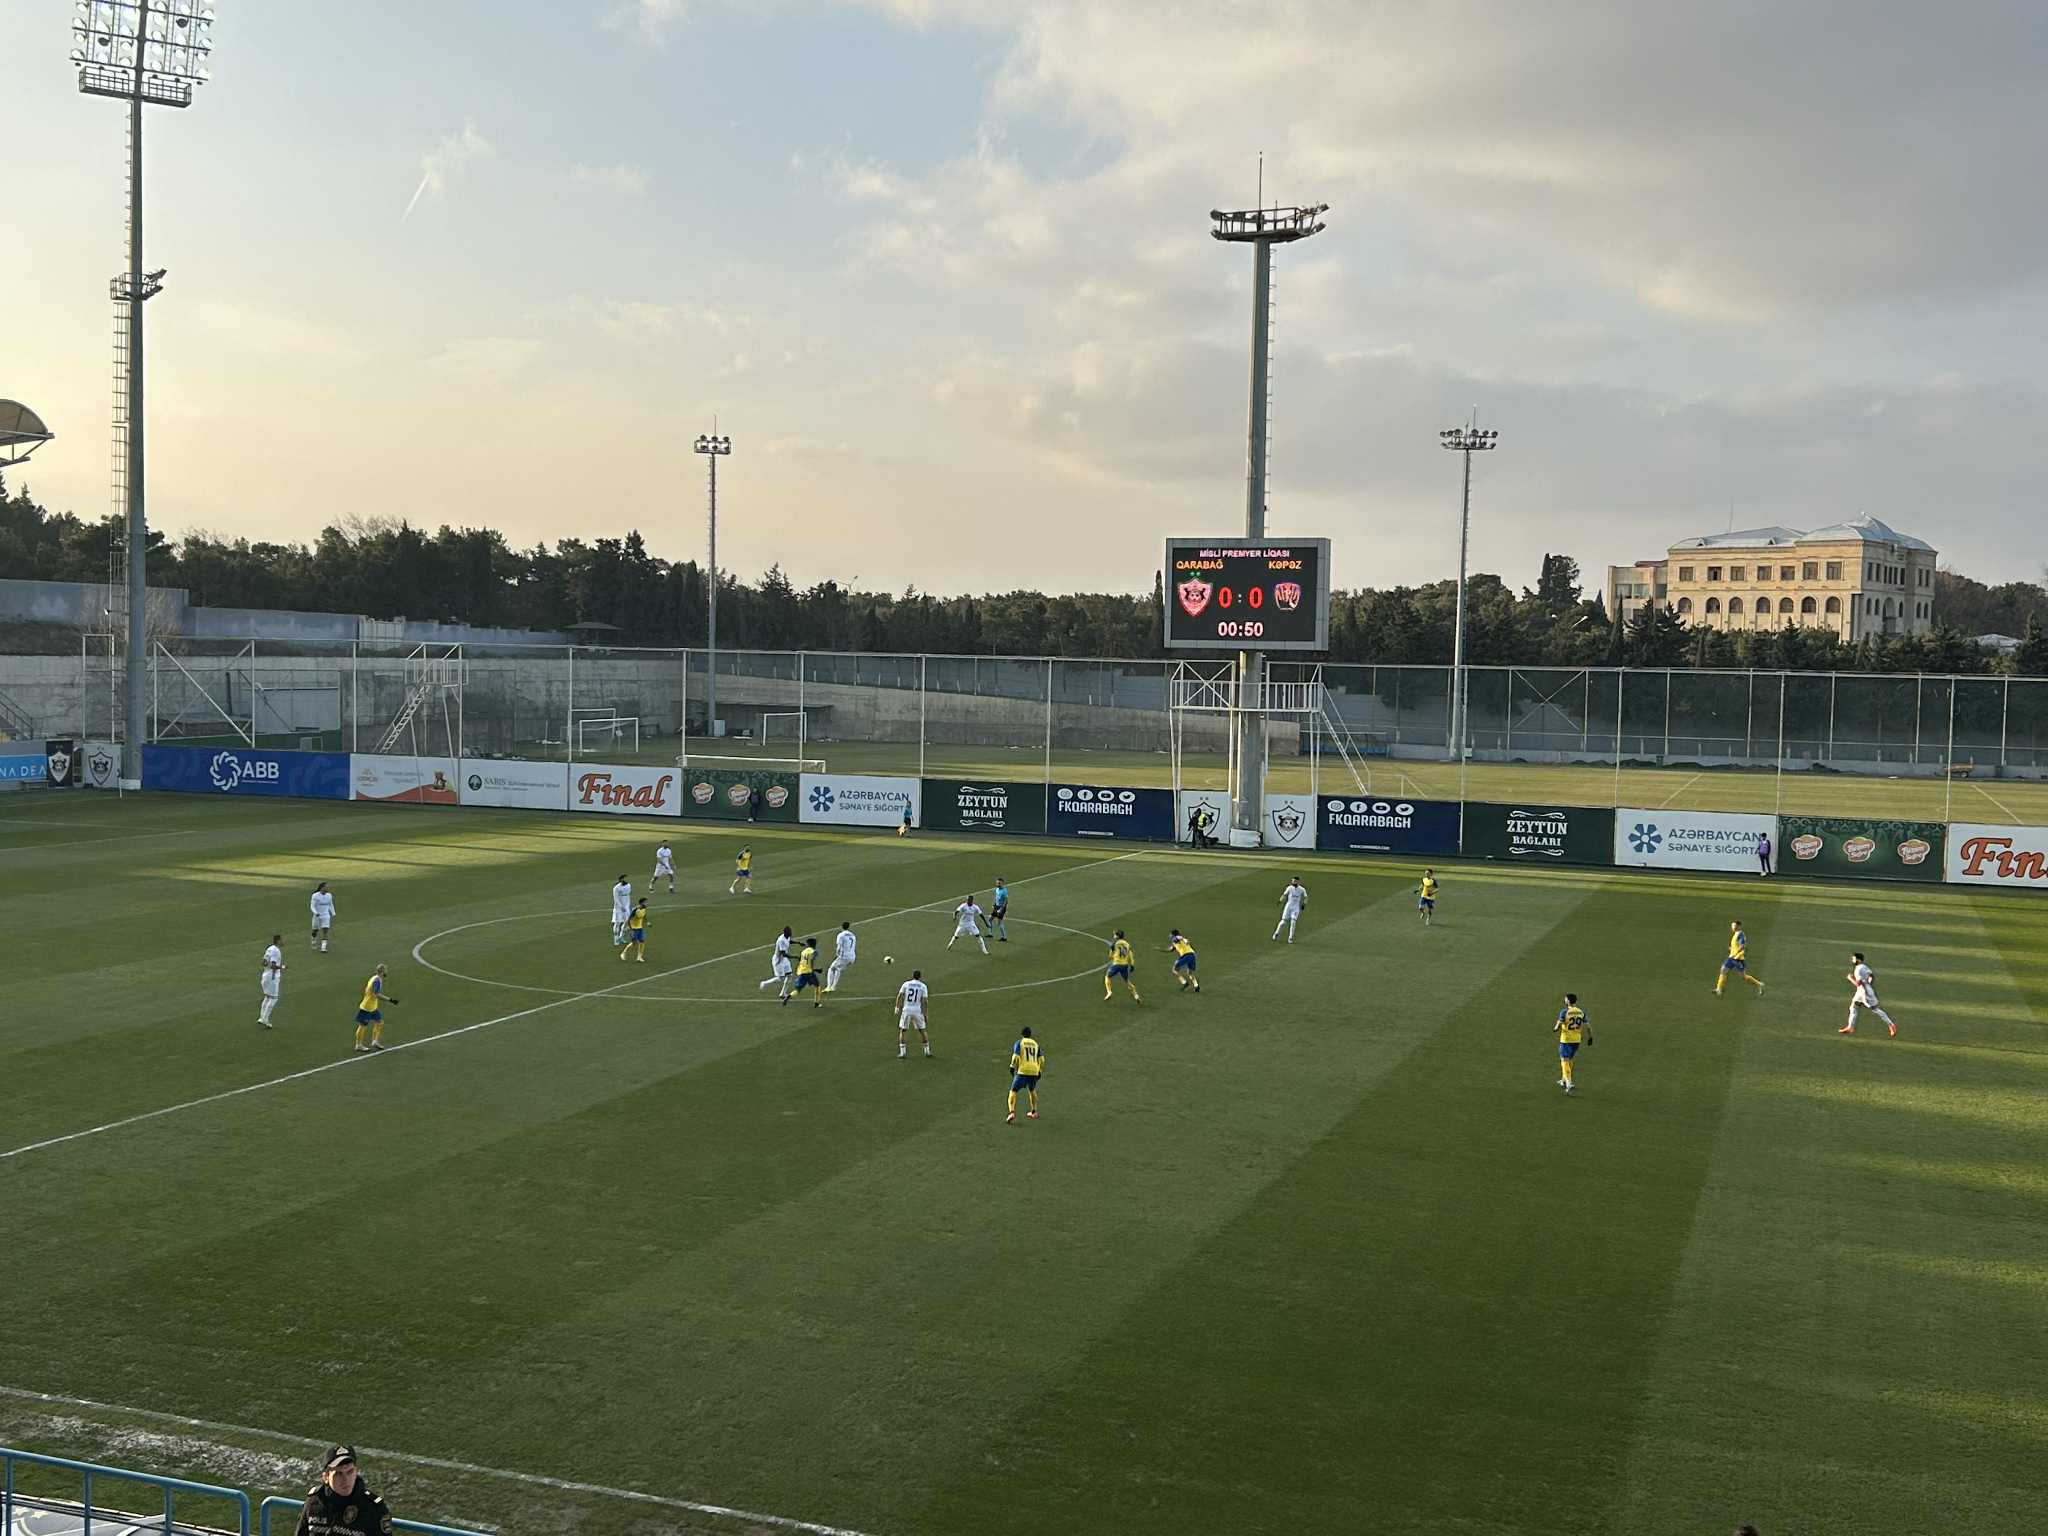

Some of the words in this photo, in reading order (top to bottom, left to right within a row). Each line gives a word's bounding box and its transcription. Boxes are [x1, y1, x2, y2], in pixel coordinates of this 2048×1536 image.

[1222, 550, 1261, 558] PREMYER
[1176, 559, 1224, 570] QARABAĞ
[1268, 561, 1302, 570] KƏPƏZ
[1218, 586, 1233, 608] 0
[1248, 586, 1264, 608] 0
[1217, 621, 1264, 637] 00:50
[242, 760, 279, 779] ABB
[578, 773, 673, 808] Final
[840, 790, 909, 801] AZƏRBAYCAN
[839, 803, 873, 811] SƏNAYE
[957, 794, 1008, 808] ZEYTUN
[1058, 800, 1133, 815] FKQARABAGH
[1328, 813, 1411, 829] FKQARABAGH
[1506, 820, 1568, 835] ZEYTUN
[1668, 828, 1762, 842] AZƏRBAYCAN
[1667, 842, 1712, 853] SƏNAYE
[1960, 837, 2048, 879] Fin
[907, 988, 918, 1002] 21
